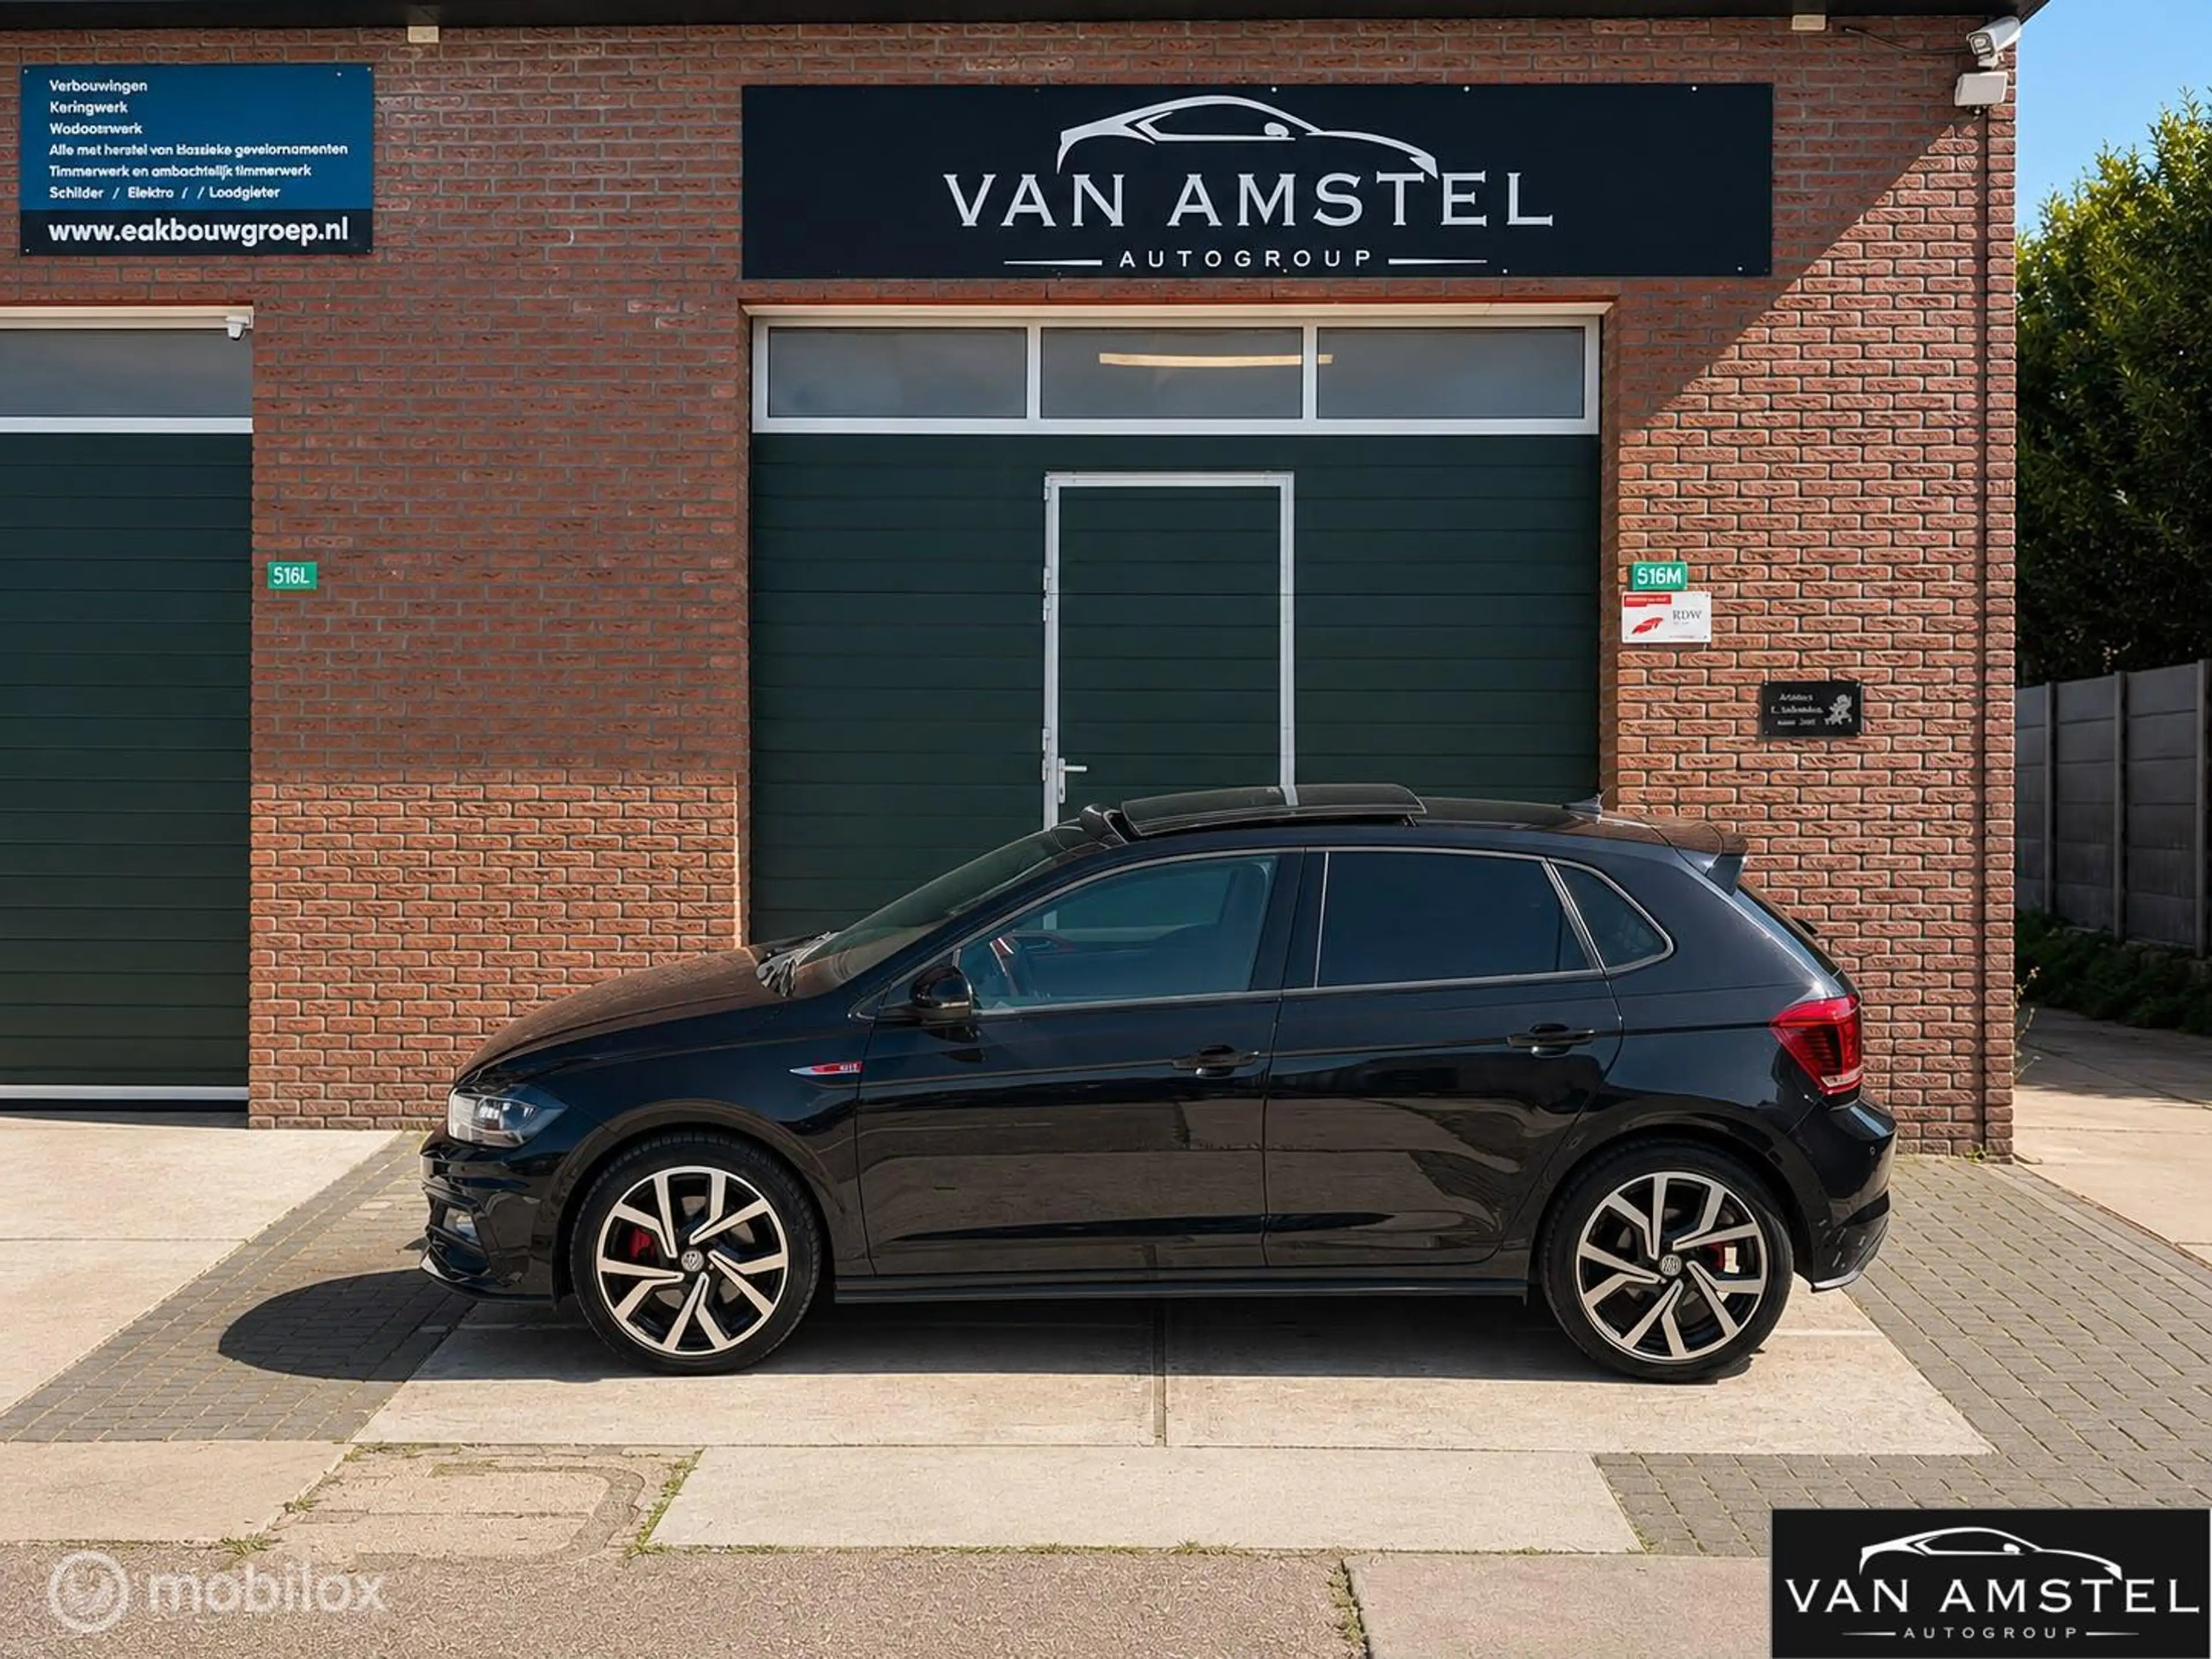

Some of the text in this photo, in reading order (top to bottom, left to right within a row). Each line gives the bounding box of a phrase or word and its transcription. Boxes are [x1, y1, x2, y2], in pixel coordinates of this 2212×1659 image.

[49, 79, 147, 94] Verbouwingen
[49, 143, 74, 156] Alle
[77, 145, 101, 156] met
[149, 146, 173, 155] van
[49, 165, 130, 177] Timmerwerk
[132, 168, 149, 177] en
[234, 164, 311, 176] timmerwerk
[50, 186, 104, 199] Schilder
[128, 186, 174, 198] Elektro
[209, 185, 281, 201] Loodgieter
[943, 171, 1554, 227] VAN AMSTEL
[48, 216, 348, 247] www.eakbouwgroep.nl
[1119, 249, 1371, 268] AUTOGROUP
[274, 566, 310, 585] 516L
[1637, 567, 1681, 585] 516M
[1672, 609, 1702, 620] RDW
